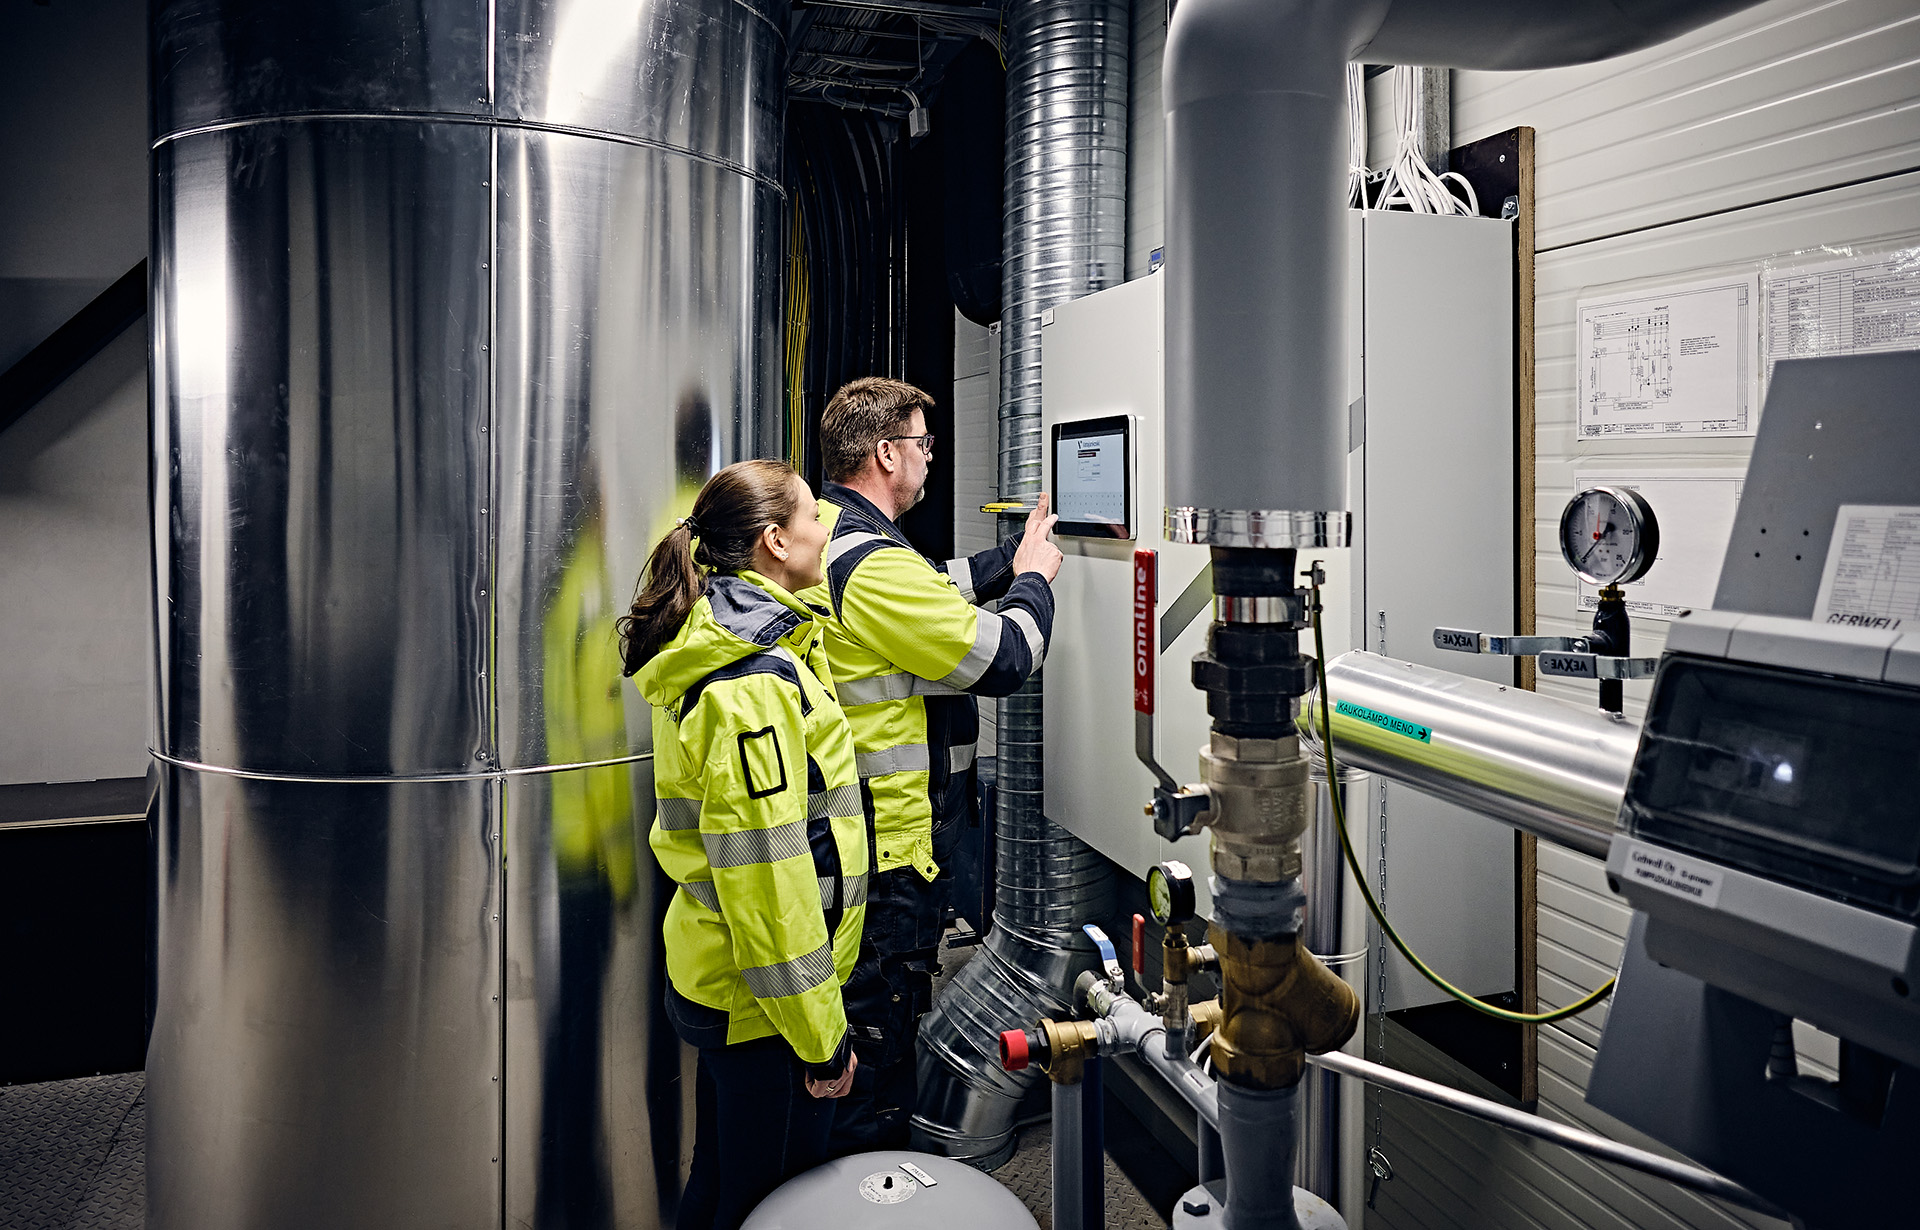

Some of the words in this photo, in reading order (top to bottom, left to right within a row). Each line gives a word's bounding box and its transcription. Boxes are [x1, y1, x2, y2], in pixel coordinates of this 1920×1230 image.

[1135, 567, 1147, 676] onnline
[1443, 634, 1473, 648] VEXVE
[1551, 658, 1587, 672] VEXVE
[1338, 702, 1389, 726] KAUKOLÄMPÖ
[1390, 719, 1414, 735] MENO
